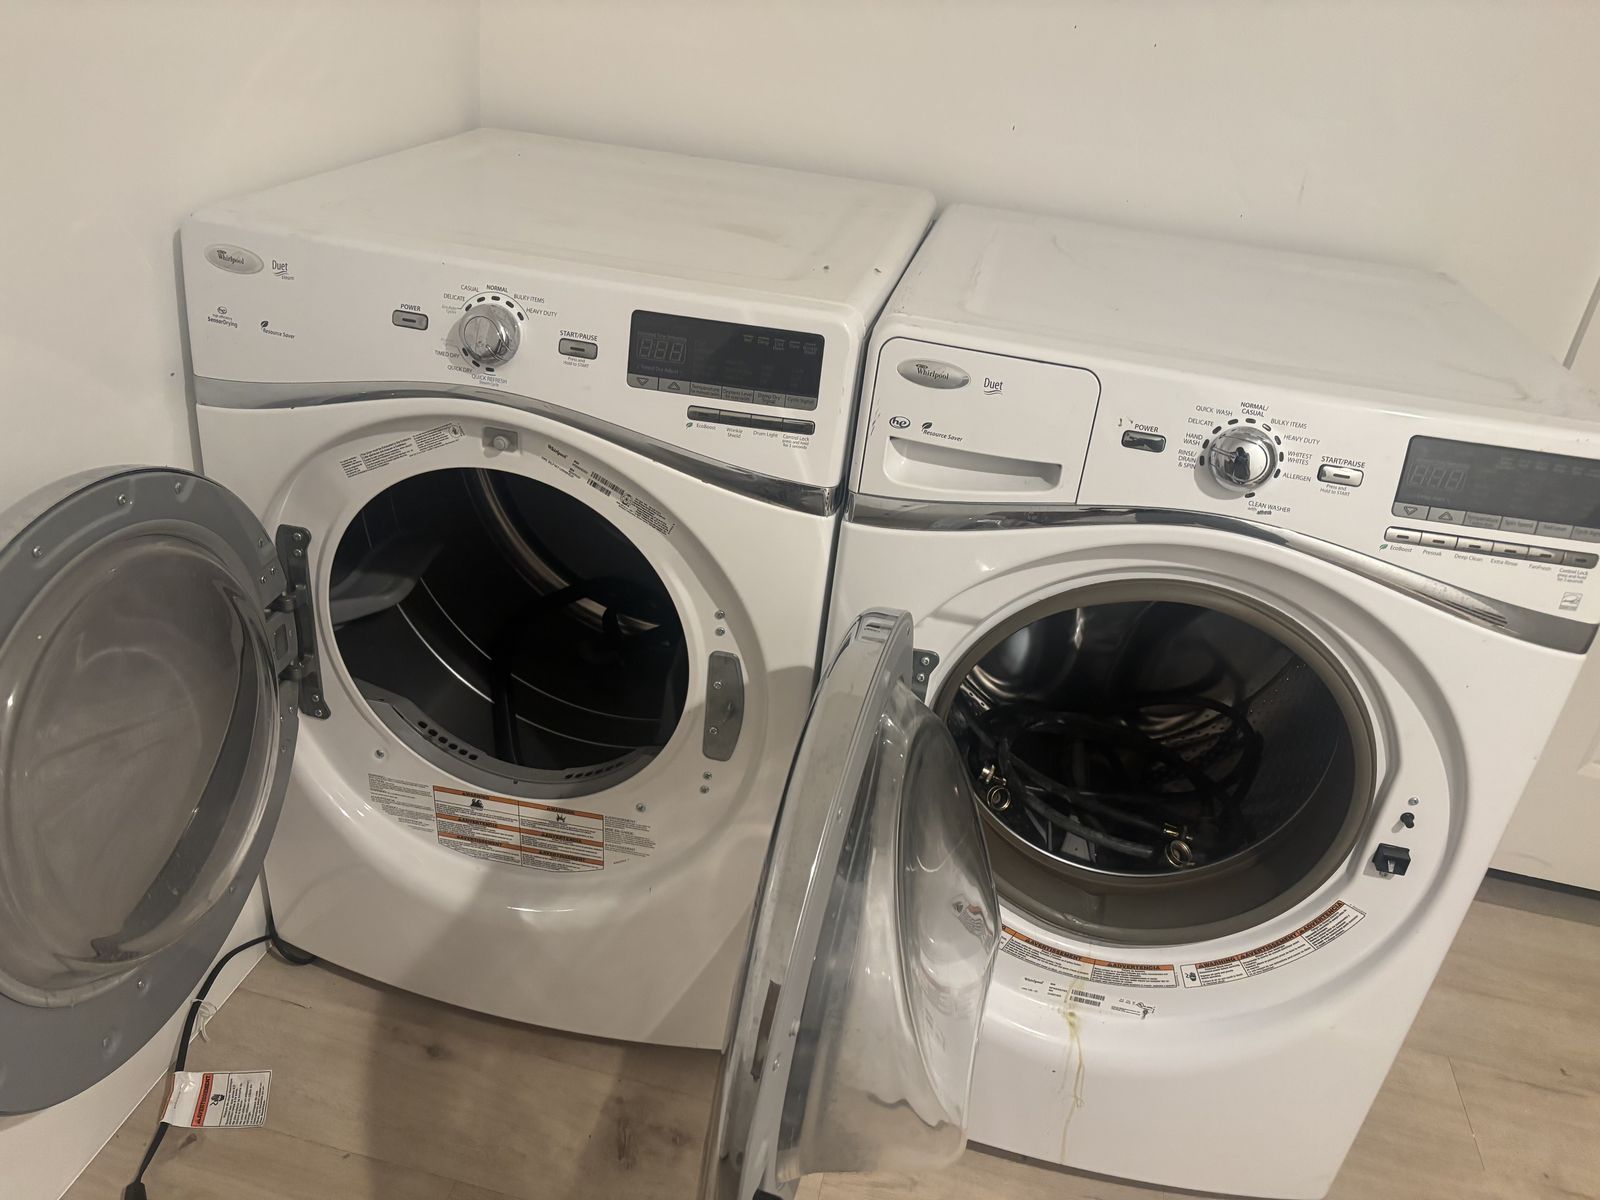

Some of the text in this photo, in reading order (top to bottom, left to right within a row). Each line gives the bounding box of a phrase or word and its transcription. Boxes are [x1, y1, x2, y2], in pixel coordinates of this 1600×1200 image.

[217, 252, 244, 264] Whirlpool
[272, 260, 288, 271] Duet
[461, 284, 479, 292] CASUAL
[486, 284, 508, 293] NORMAL
[443, 293, 465, 301] DELICATE
[514, 294, 528, 302] BULKY
[207, 316, 238, 328] SensorDrying
[263, 328, 282, 336] Resource
[560, 330, 598, 341] START/PAUSE
[447, 365, 462, 373] QUICK
[917, 368, 949, 380] Whirlpool
[487, 376, 508, 384] REFRESH
[984, 378, 1004, 390] Duet
[1195, 405, 1233, 416] QUICK WASH
[1240, 402, 1269, 411] NORMAL/
[1241, 409, 1264, 417] CASUAL
[1188, 417, 1214, 427] DELICATE
[1271, 418, 1307, 429] BULKY ITEMS
[1134, 424, 1159, 432] POWER
[923, 430, 963, 442] Resource Saver
[1186, 432, 1203, 440] HAND
[1283, 434, 1320, 445] HEAVY DUTY
[1178, 449, 1197, 457] RINSE/
[1287, 451, 1312, 460] WHITEST
[1178, 455, 1196, 463] DRAIN
[1287, 457, 1309, 465] WHITES
[1321, 456, 1366, 468] START/PAUSE
[1282, 472, 1312, 482] ALLERGEN
[1248, 501, 1290, 512] CLEAN WASHER
[1303, 900, 1345, 931] ADVERTENCIA
[1030, 939, 1083, 962] AVERTISSEMENT
[1111, 961, 1161, 971] ADVERTENCIA
[1202, 956, 1236, 968] WARNING
